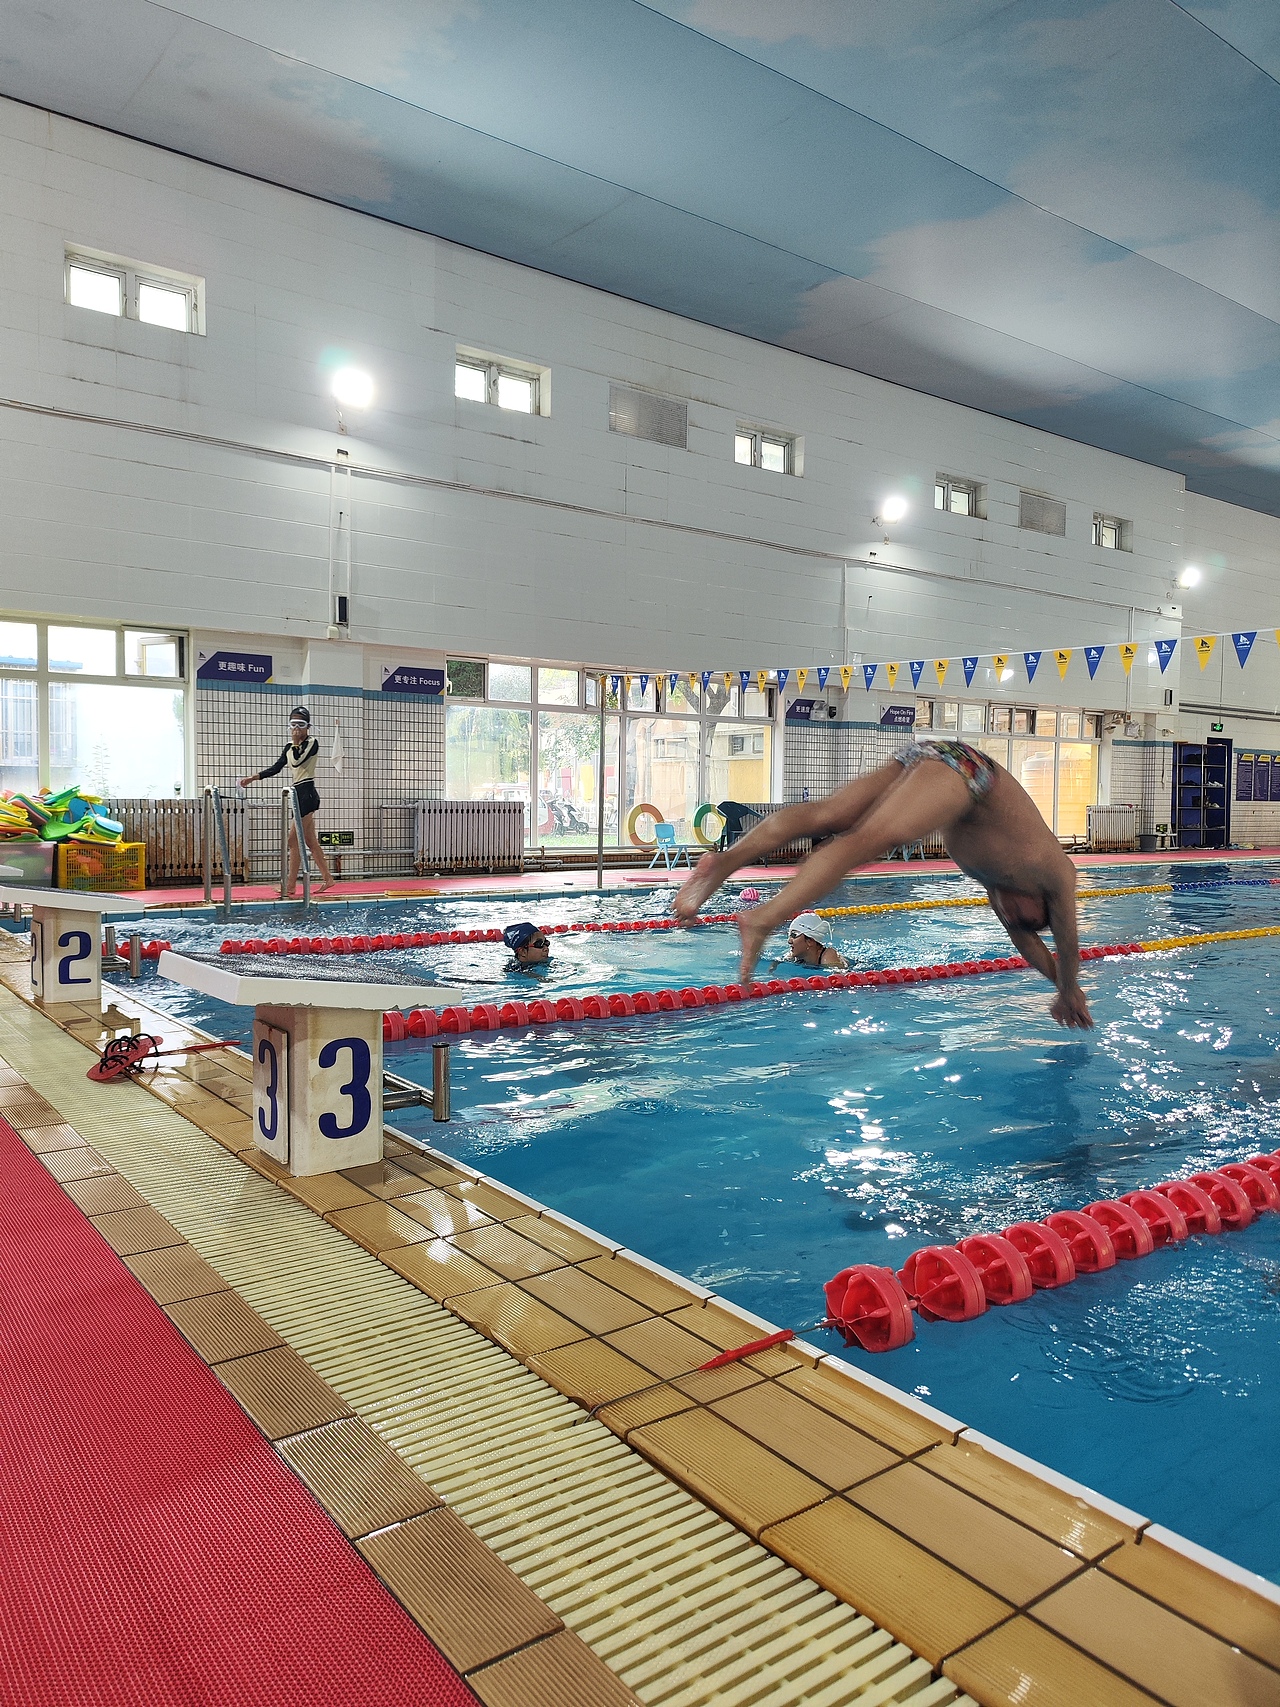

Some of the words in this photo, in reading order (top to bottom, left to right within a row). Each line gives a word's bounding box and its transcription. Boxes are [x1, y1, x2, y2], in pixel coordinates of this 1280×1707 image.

[217, 661, 246, 672] 更趣味
[248, 664, 265, 673] Fun
[394, 675, 417, 685] 更专注
[419, 677, 441, 686] Focus
[58, 930, 92, 984] 2
[258, 1038, 278, 1140] 3
[318, 1037, 372, 1139] 3
